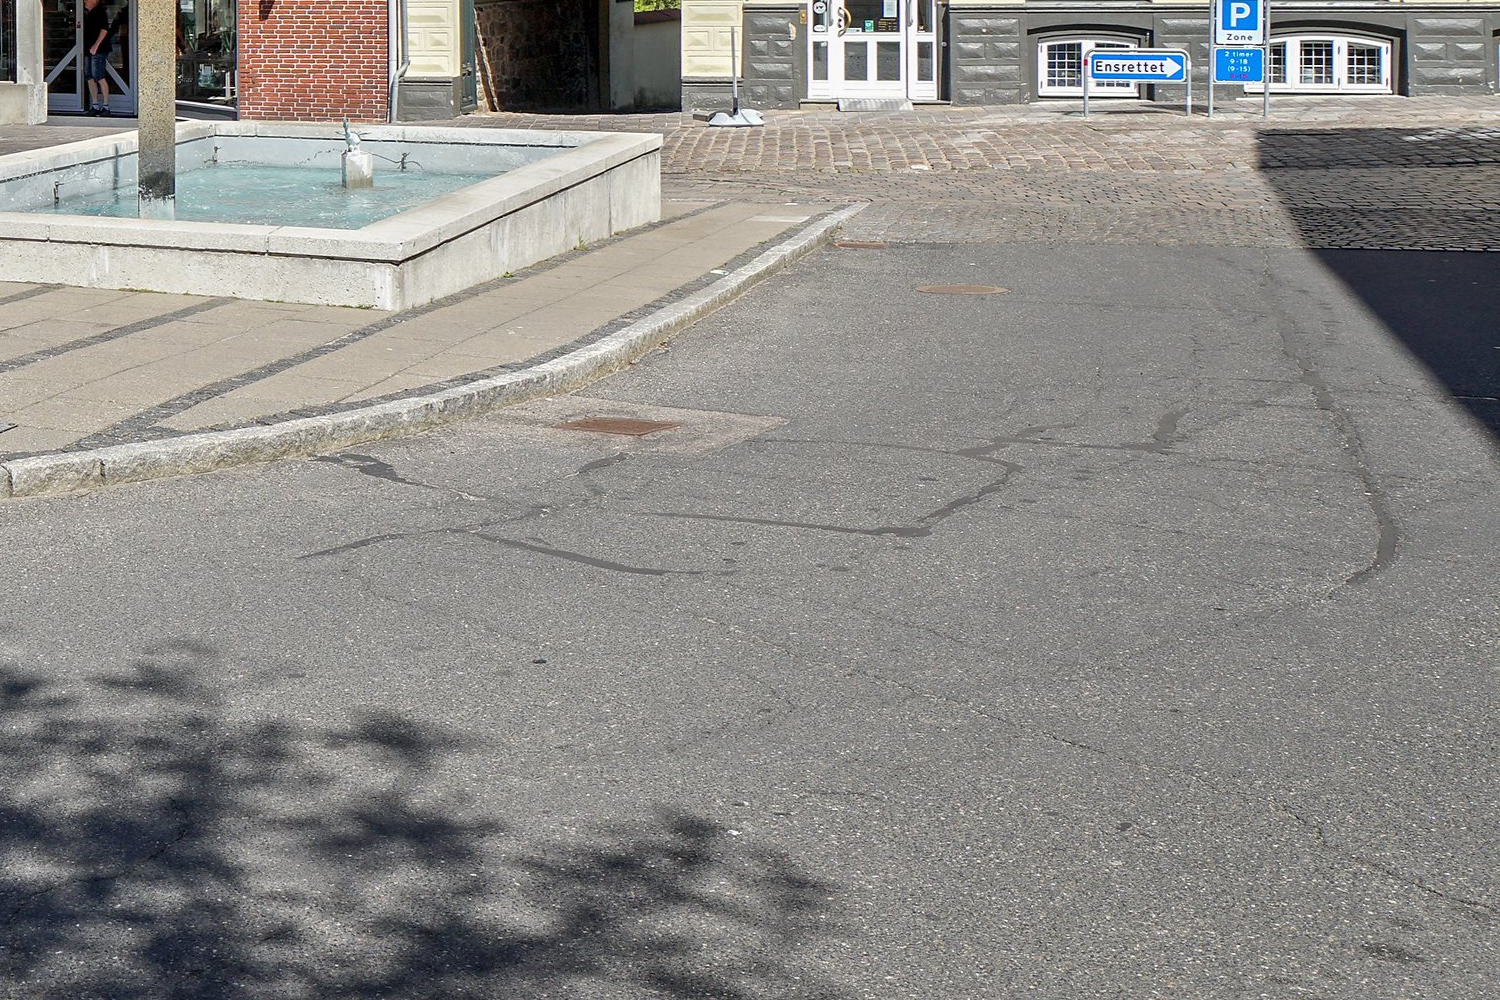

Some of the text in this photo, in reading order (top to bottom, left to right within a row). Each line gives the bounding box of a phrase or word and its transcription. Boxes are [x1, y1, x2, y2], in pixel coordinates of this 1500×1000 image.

[1230, 2, 1251, 28] P
[1227, 33, 1253, 41] Zone
[1095, 60, 1165, 73] Ensrettet
